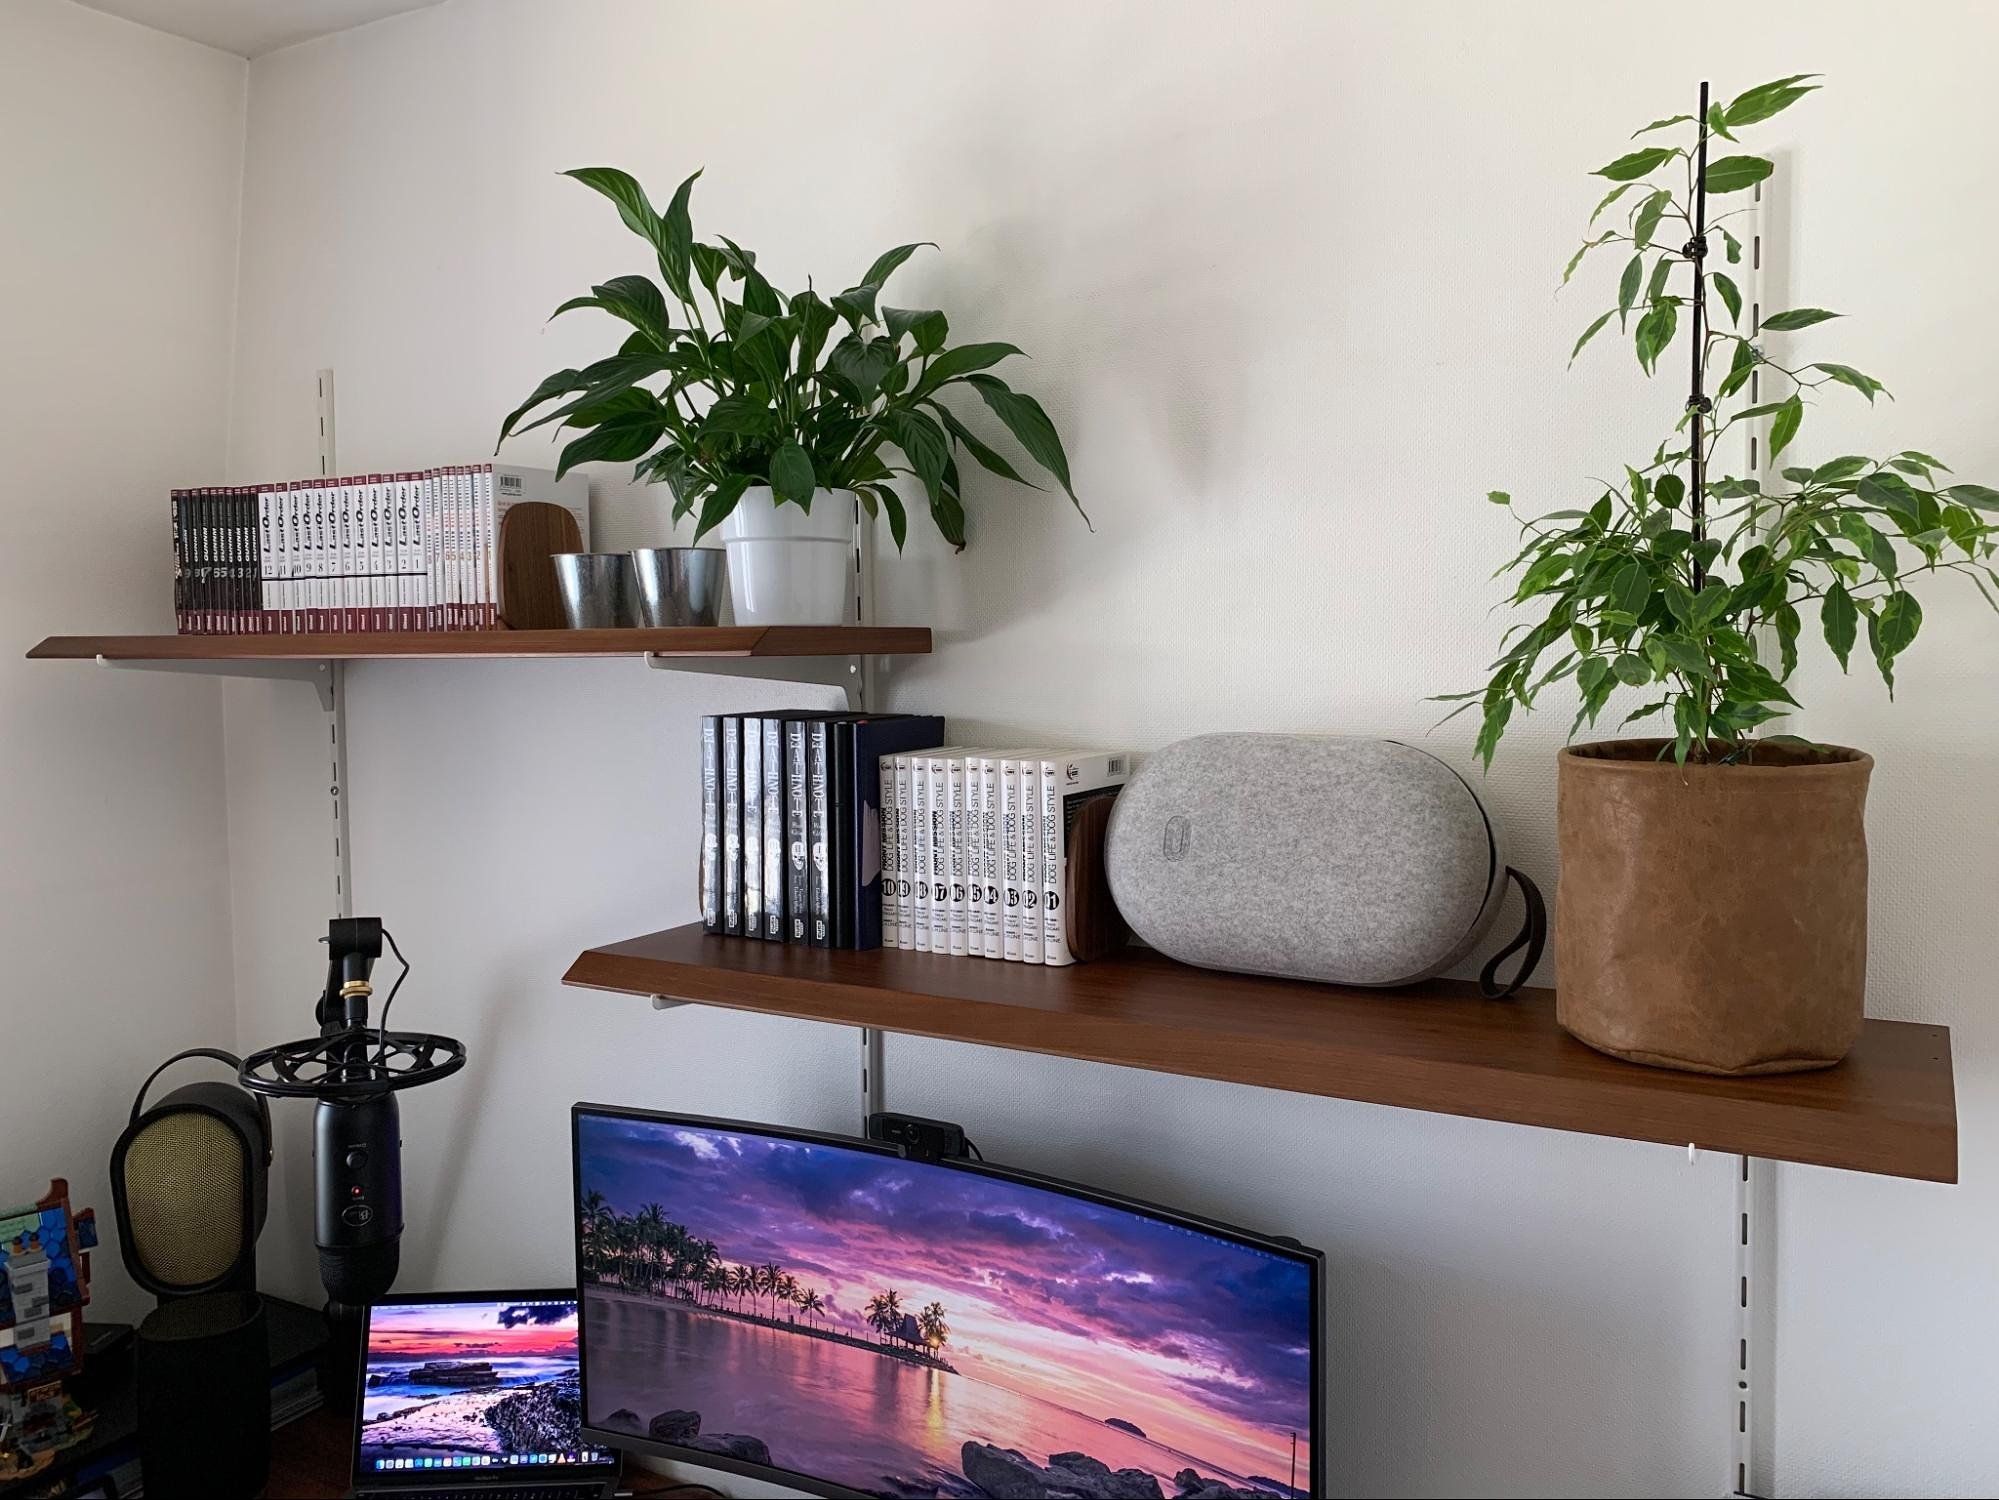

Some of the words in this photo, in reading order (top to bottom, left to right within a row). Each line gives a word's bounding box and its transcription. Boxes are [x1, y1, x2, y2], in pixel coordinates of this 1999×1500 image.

[726, 728, 737, 776] DEATH
[766, 731, 778, 779] DEATH
[790, 733, 802, 782] DEATH
[812, 733, 823, 783] DEATH
[727, 776, 738, 810] NOTE
[768, 780, 779, 814] NOTE
[792, 782, 803, 817] NOTE
[813, 783, 824, 818] NOTE
[884, 779, 892, 805] STYLE
[899, 780, 907, 805] STYLE
[971, 781, 979, 807] STYLE
[1007, 784, 1015, 810] STYLE
[1026, 785, 1034, 812] STYLE
[1047, 785, 1055, 812] STYLE
[971, 809, 979, 829] DOG
[987, 811, 995, 830] DOG
[1008, 813, 1016, 832] DOG
[1026, 813, 1034, 834] DOG
[1048, 814, 1056, 834] DOG
[900, 835, 908, 851] LIFE
[918, 835, 926, 852] LIFE
[971, 838, 979, 854] LIFE
[987, 840, 995, 856] LIFE
[1008, 841, 1016, 858] LIFE
[1048, 844, 1056, 861] LIFE
[918, 855, 926, 874] DOG
[971, 857, 979, 877] DOG
[987, 859, 995, 879] DOG
[1008, 861, 1016, 881] DOG
[1027, 863, 1035, 883] DOG
[1048, 864, 1056, 884] DOG
